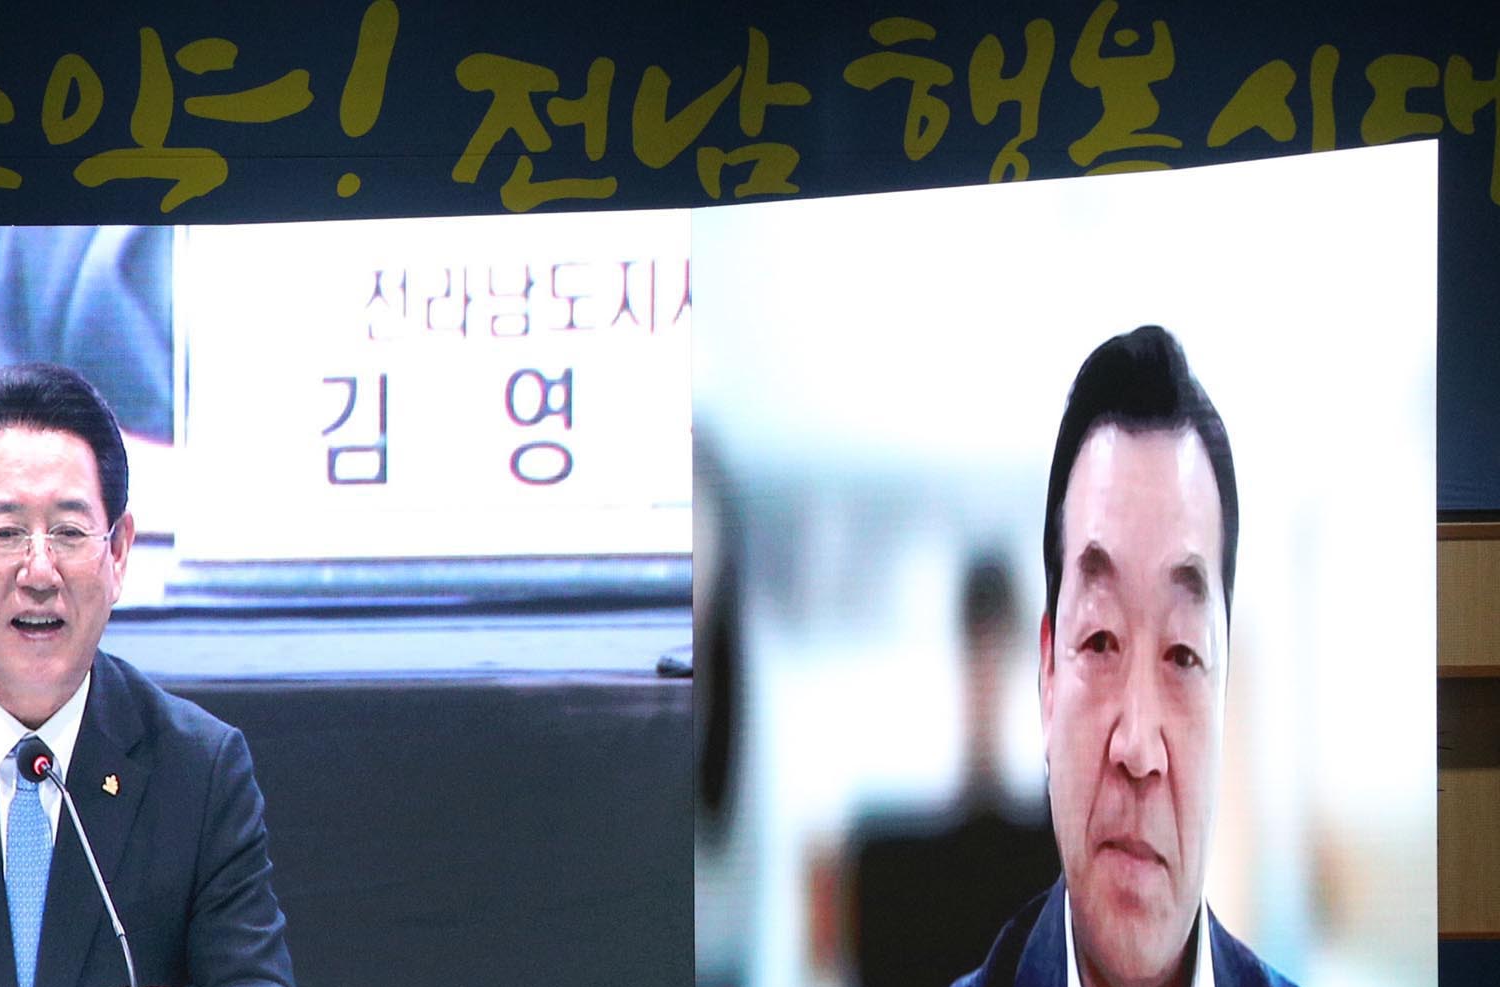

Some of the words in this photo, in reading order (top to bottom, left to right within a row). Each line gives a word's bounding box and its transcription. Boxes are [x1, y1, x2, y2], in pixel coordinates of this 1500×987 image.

[452, 27, 811, 212] 전남
[842, 0, 1183, 183] 행복
[1206, 44, 1500, 206] 시대
